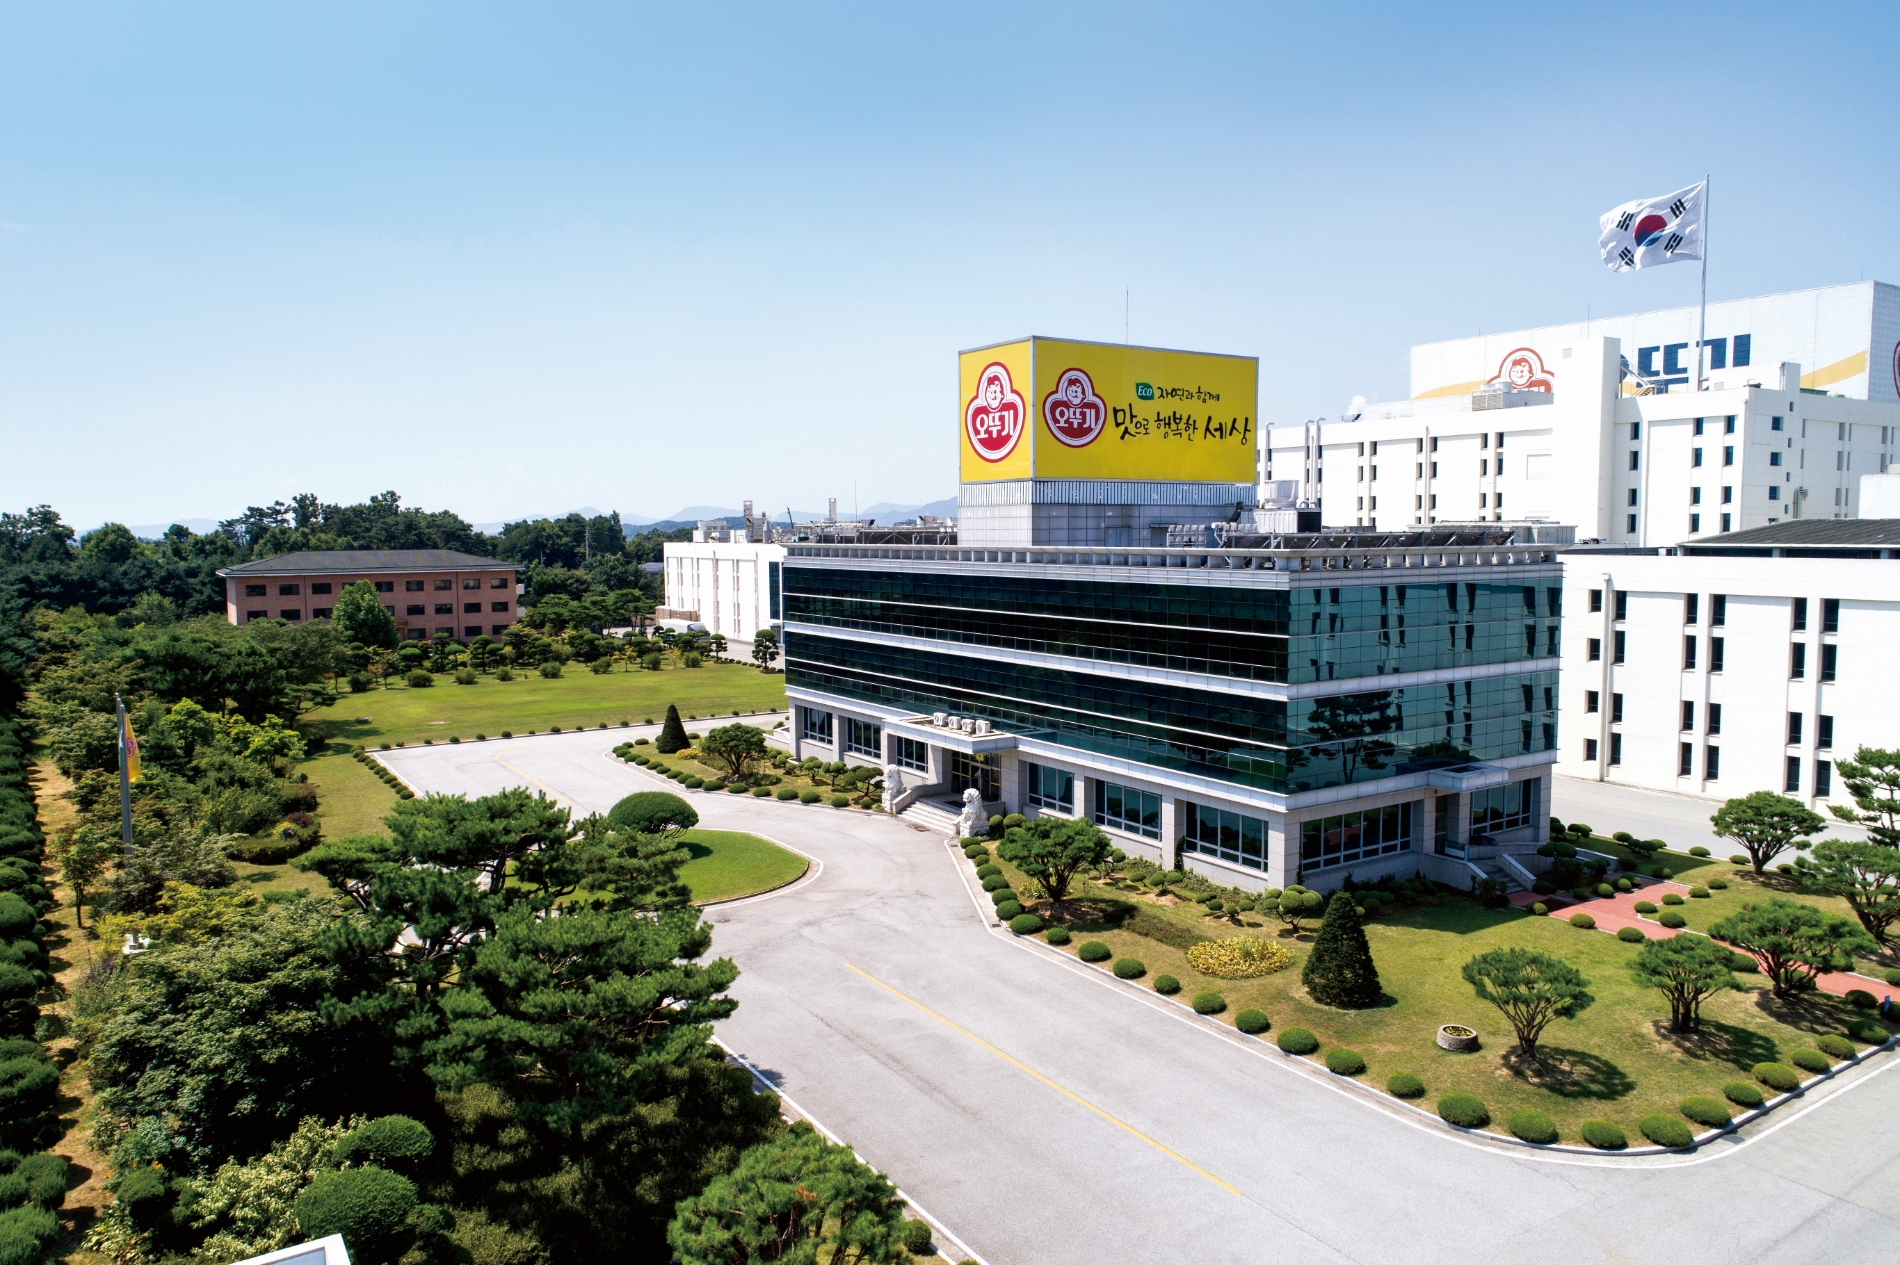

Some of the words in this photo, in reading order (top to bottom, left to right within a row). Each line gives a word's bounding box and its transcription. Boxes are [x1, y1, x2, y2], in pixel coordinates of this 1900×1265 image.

[1157, 386, 1195, 401] 자연과
[1195, 385, 1220, 404] 함께
[976, 409, 1014, 439] 오뚜기
[1055, 406, 1096, 429] 오뚜기
[1112, 402, 1151, 441] 맛으로
[1154, 410, 1199, 442] 행복한
[1203, 415, 1252, 446] 세상
